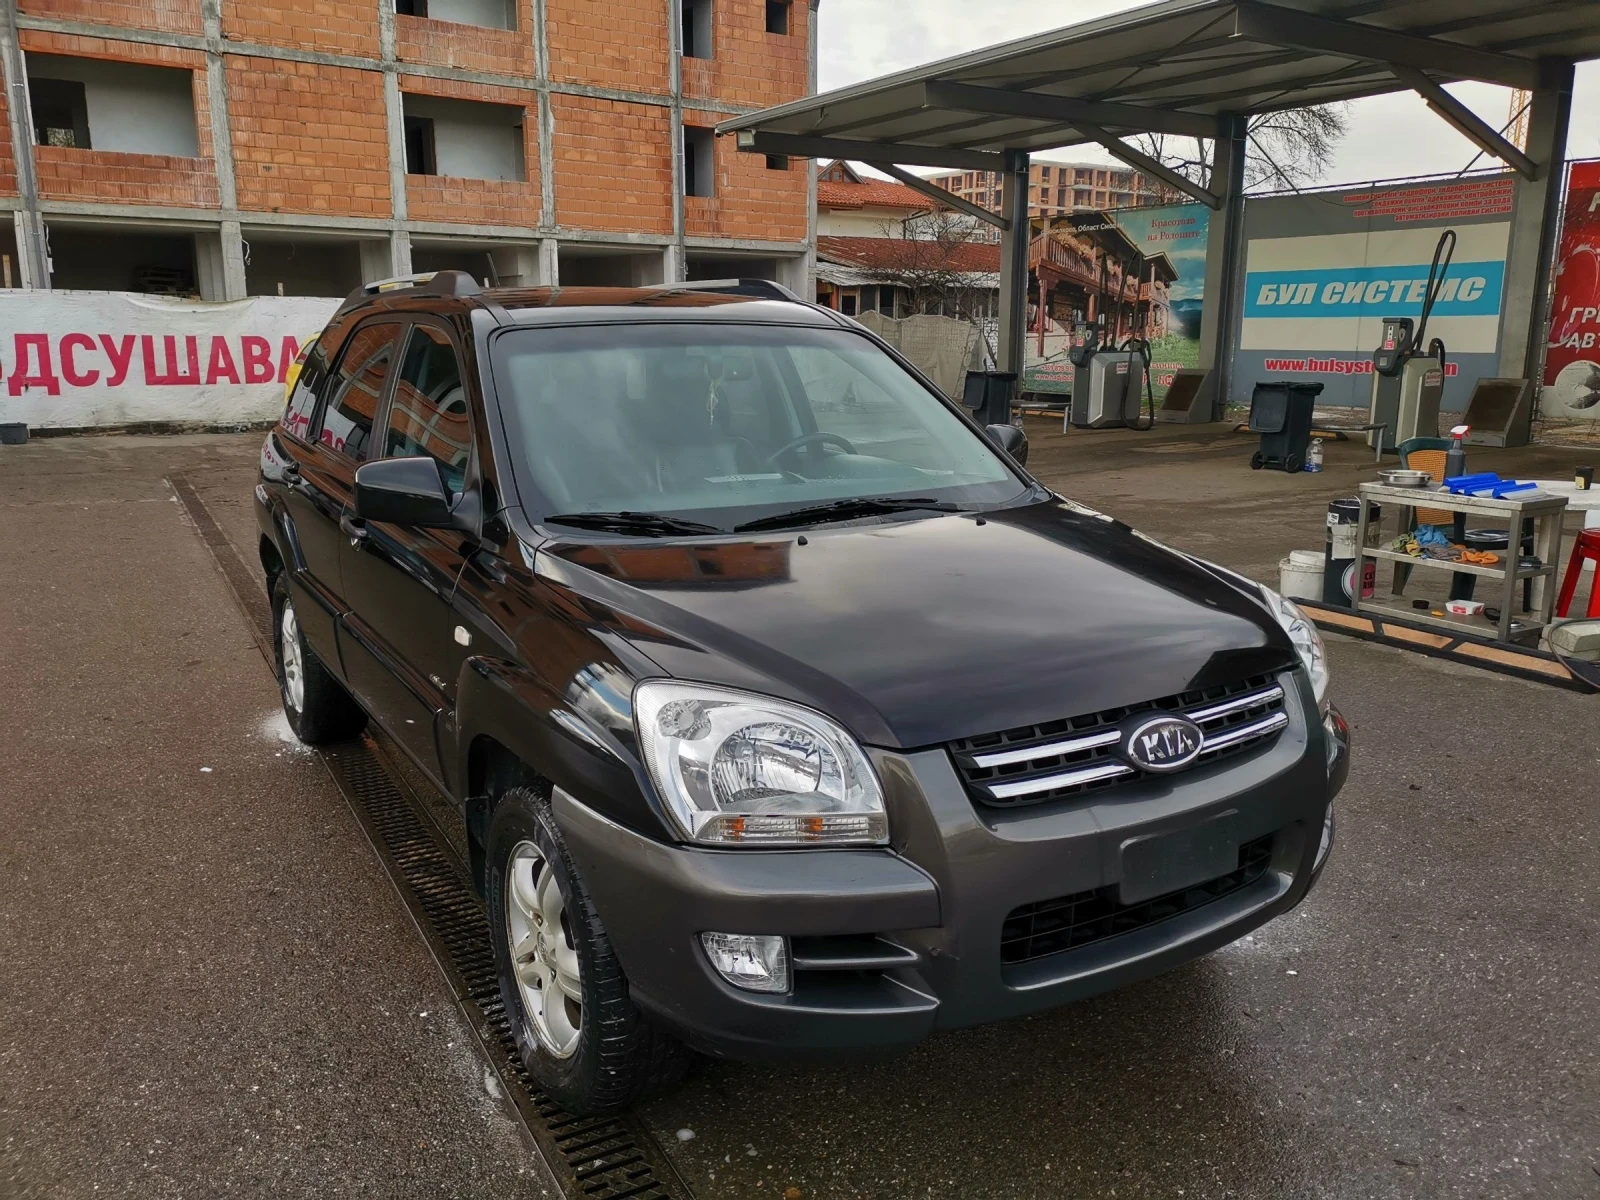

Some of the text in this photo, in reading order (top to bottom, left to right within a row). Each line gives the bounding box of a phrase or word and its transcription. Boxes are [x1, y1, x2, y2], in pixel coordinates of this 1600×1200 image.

[1460, 200, 1482, 208] помпи
[1481, 205, 1512, 214] системи
[1078, 224, 1100, 232] Област
[1256, 276, 1486, 306] БУЛ СИСТЕМС
[1565, 332, 1600, 349] АВ
[1141, 727, 1195, 762] KIA
